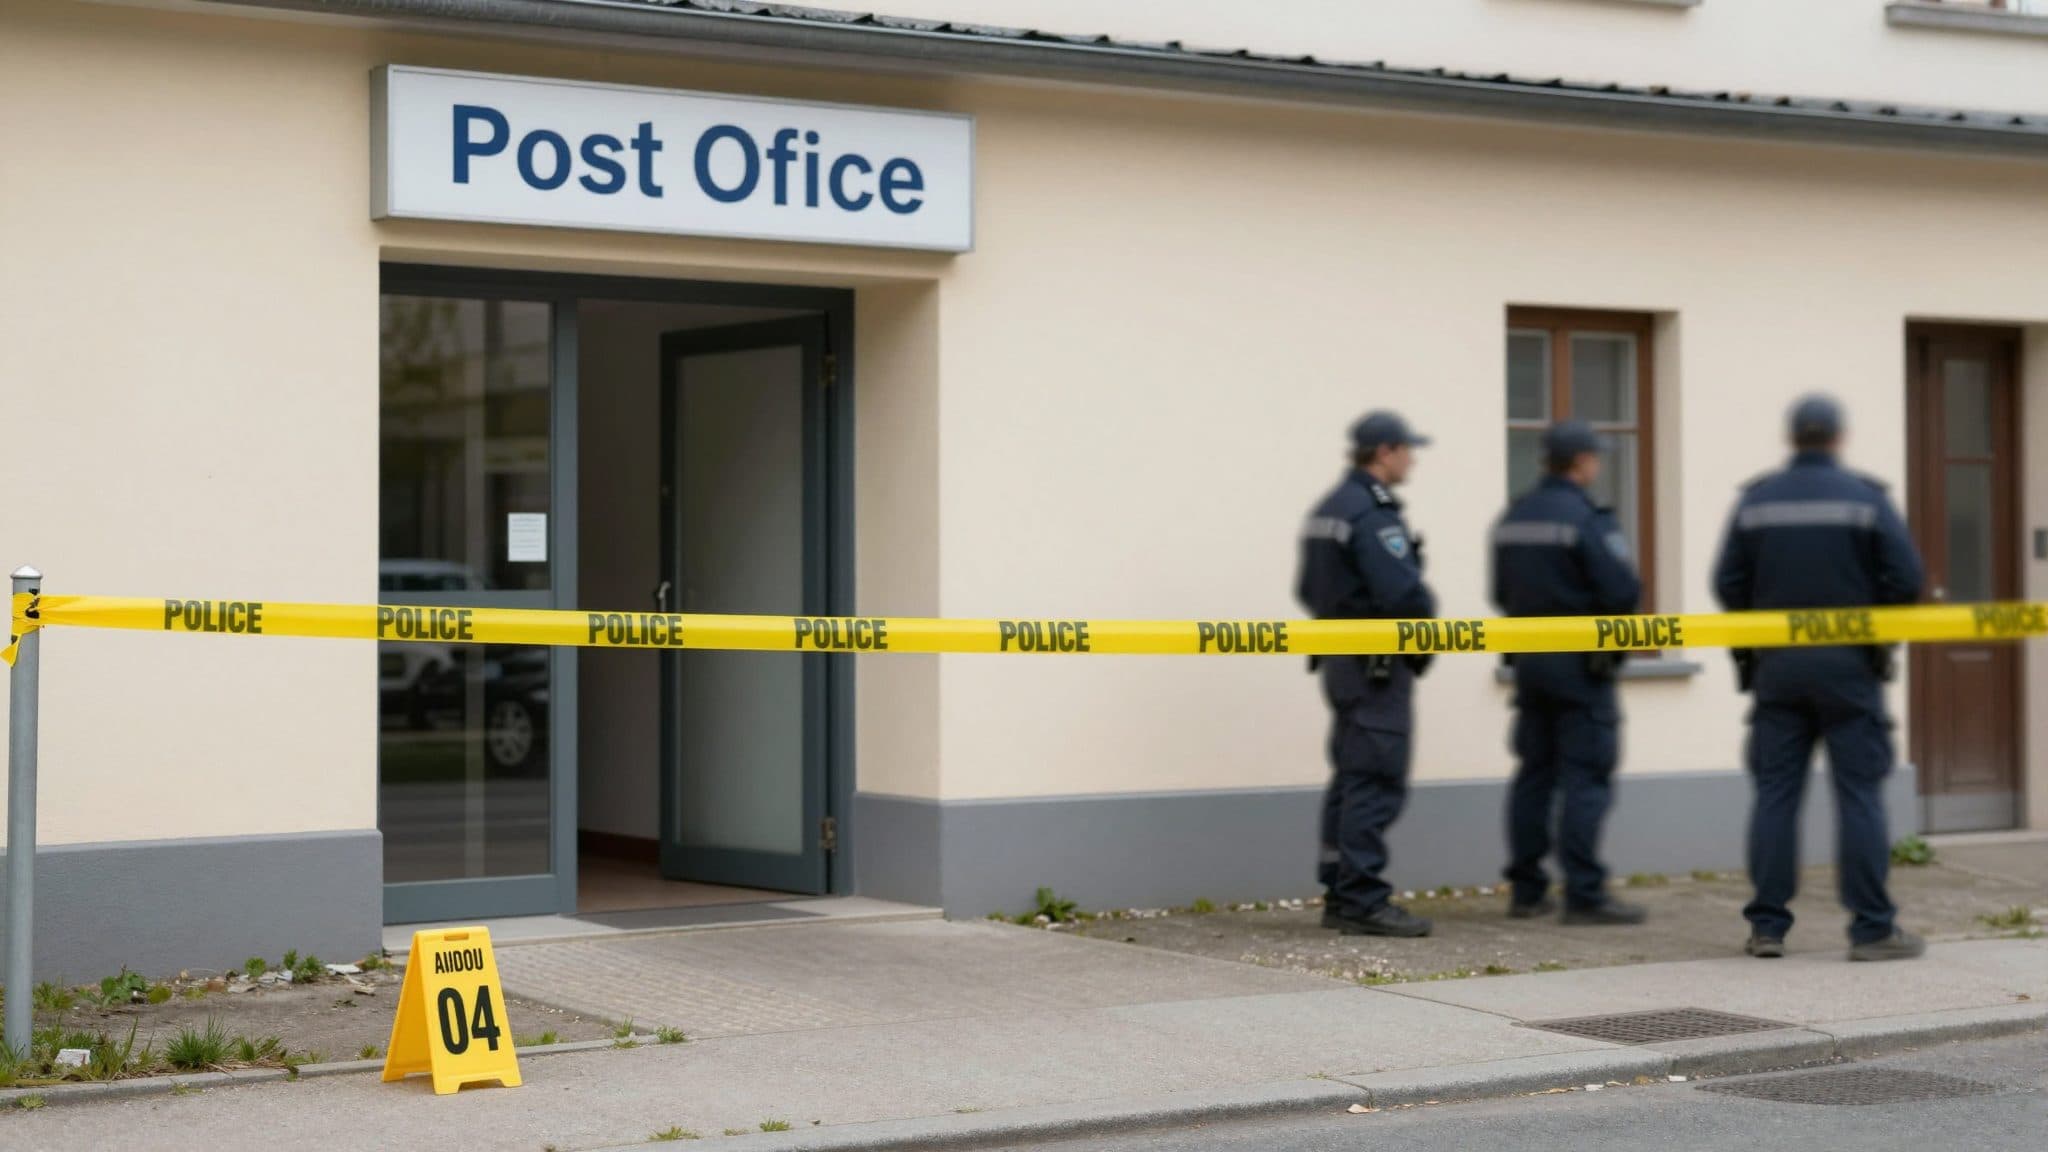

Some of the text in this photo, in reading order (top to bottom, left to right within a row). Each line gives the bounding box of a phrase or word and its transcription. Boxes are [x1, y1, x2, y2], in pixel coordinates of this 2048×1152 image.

[452, 104, 925, 214] Post Ofice
[164, 599, 262, 634] POLICE
[378, 605, 473, 641] POLICE
[588, 612, 683, 647] POLICE
[795, 618, 889, 650] POLICE
[999, 620, 1090, 653] POLICE
[1198, 621, 1289, 653] POLICE
[1397, 620, 1486, 653] POLICE
[1596, 616, 1684, 649] POLICE
[1788, 610, 1878, 643] POLICE
[437, 985, 501, 1055] 04
